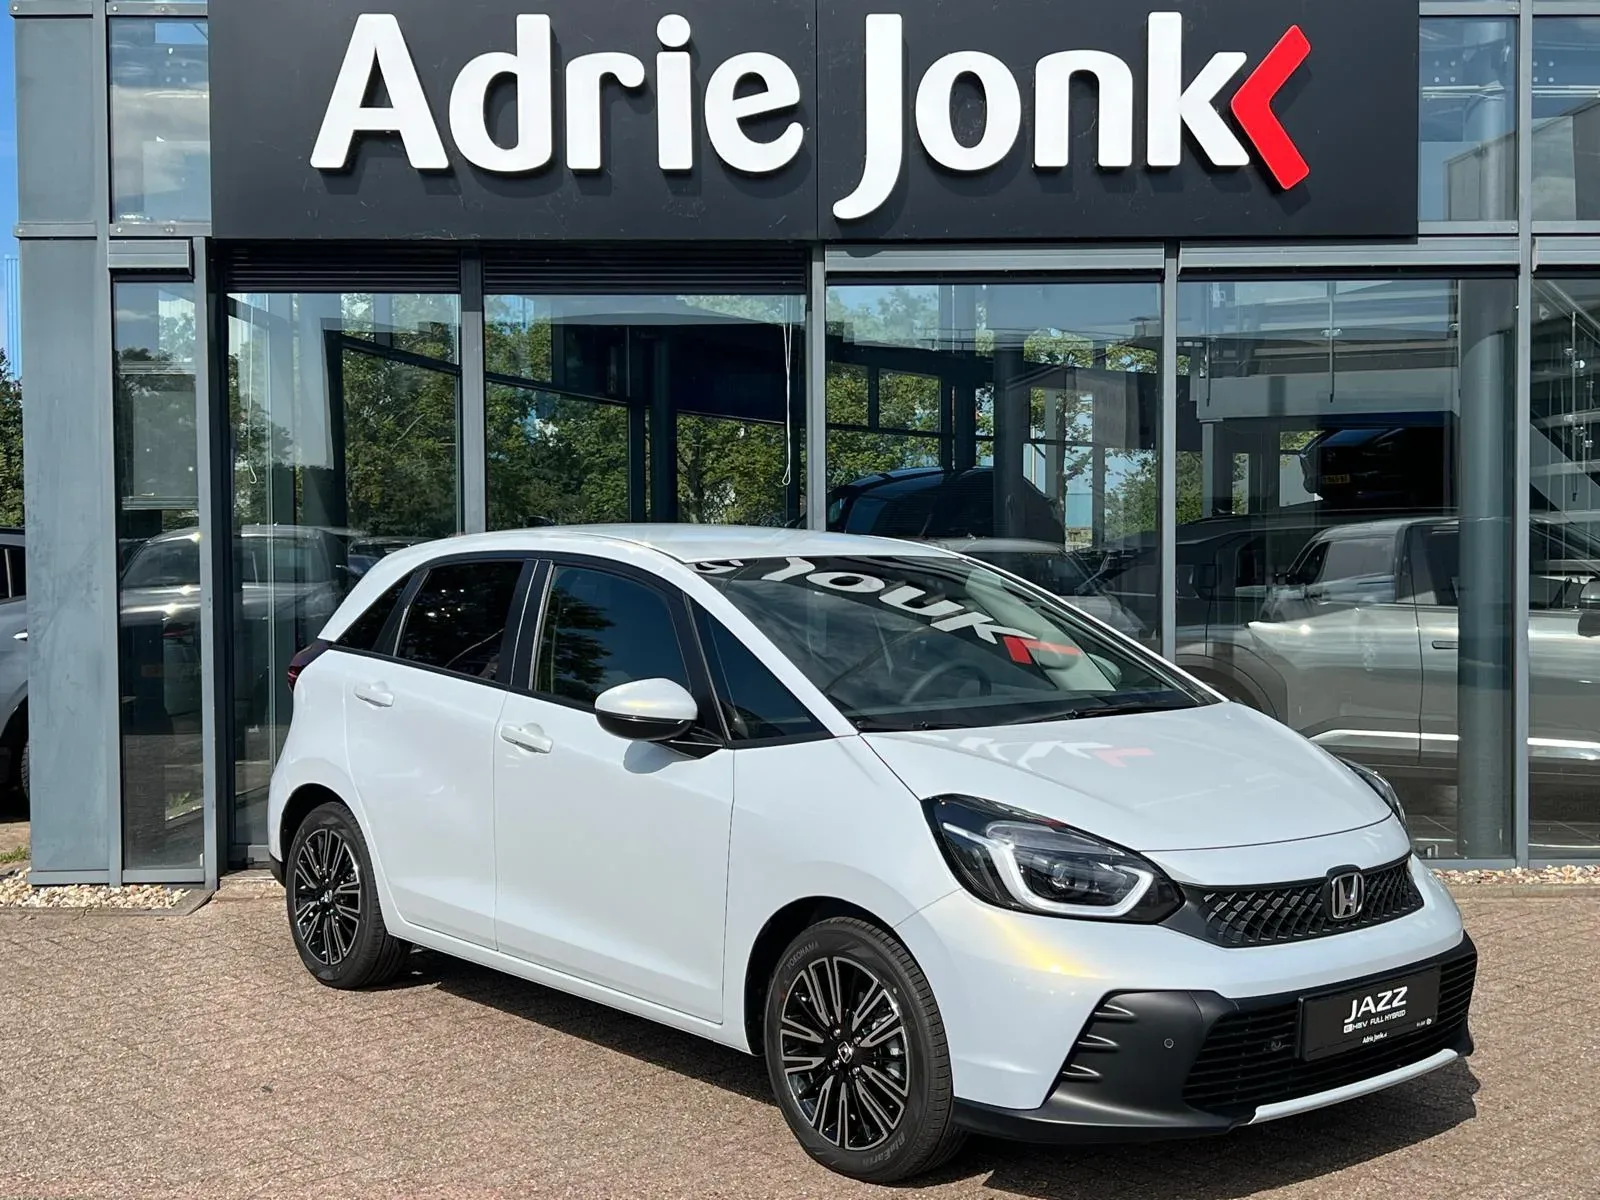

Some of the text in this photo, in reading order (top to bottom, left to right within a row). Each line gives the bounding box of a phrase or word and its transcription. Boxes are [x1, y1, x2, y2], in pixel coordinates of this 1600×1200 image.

[310, 11, 1251, 220] Adrie Jonk
[1344, 986, 1408, 1023] JAZZ
[1370, 1015, 1384, 1025] FULL
[1384, 1009, 1406, 1021] HYBRID
